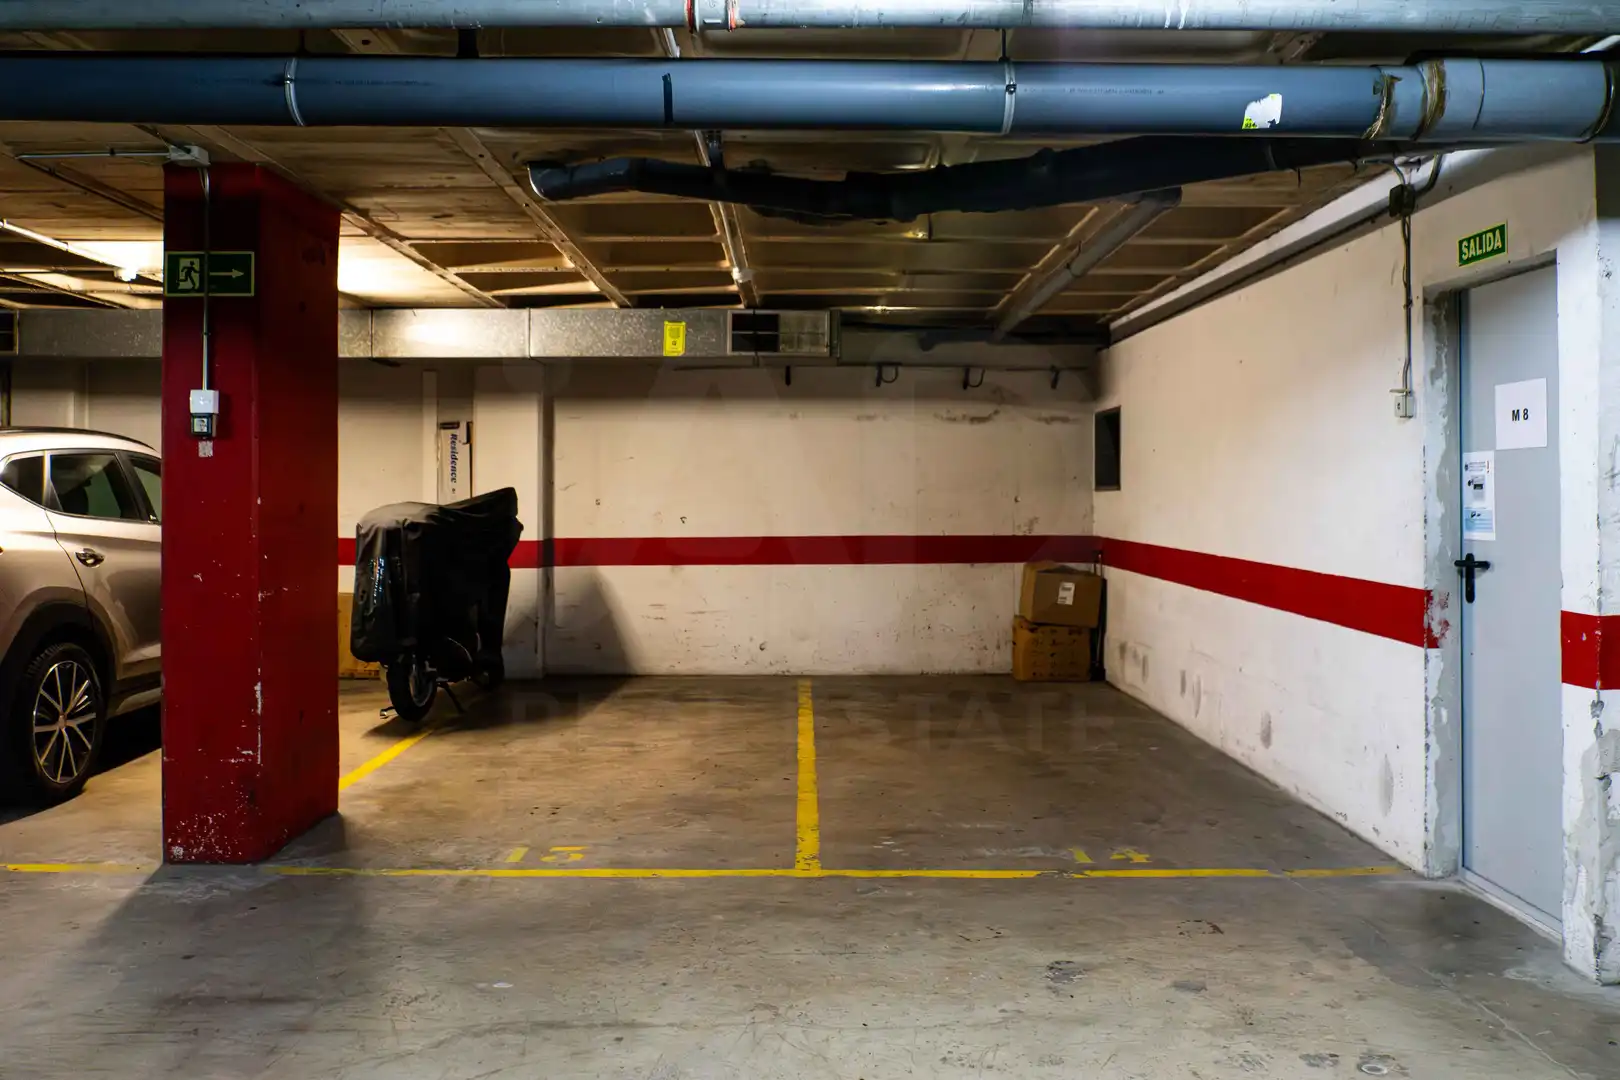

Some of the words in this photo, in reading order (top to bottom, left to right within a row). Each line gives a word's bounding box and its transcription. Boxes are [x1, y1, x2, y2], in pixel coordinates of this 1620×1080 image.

[1461, 228, 1502, 260] SALIDA
[1511, 409, 1520, 422] M
[1522, 407, 1529, 421] 8
[450, 433, 459, 483] Residence
